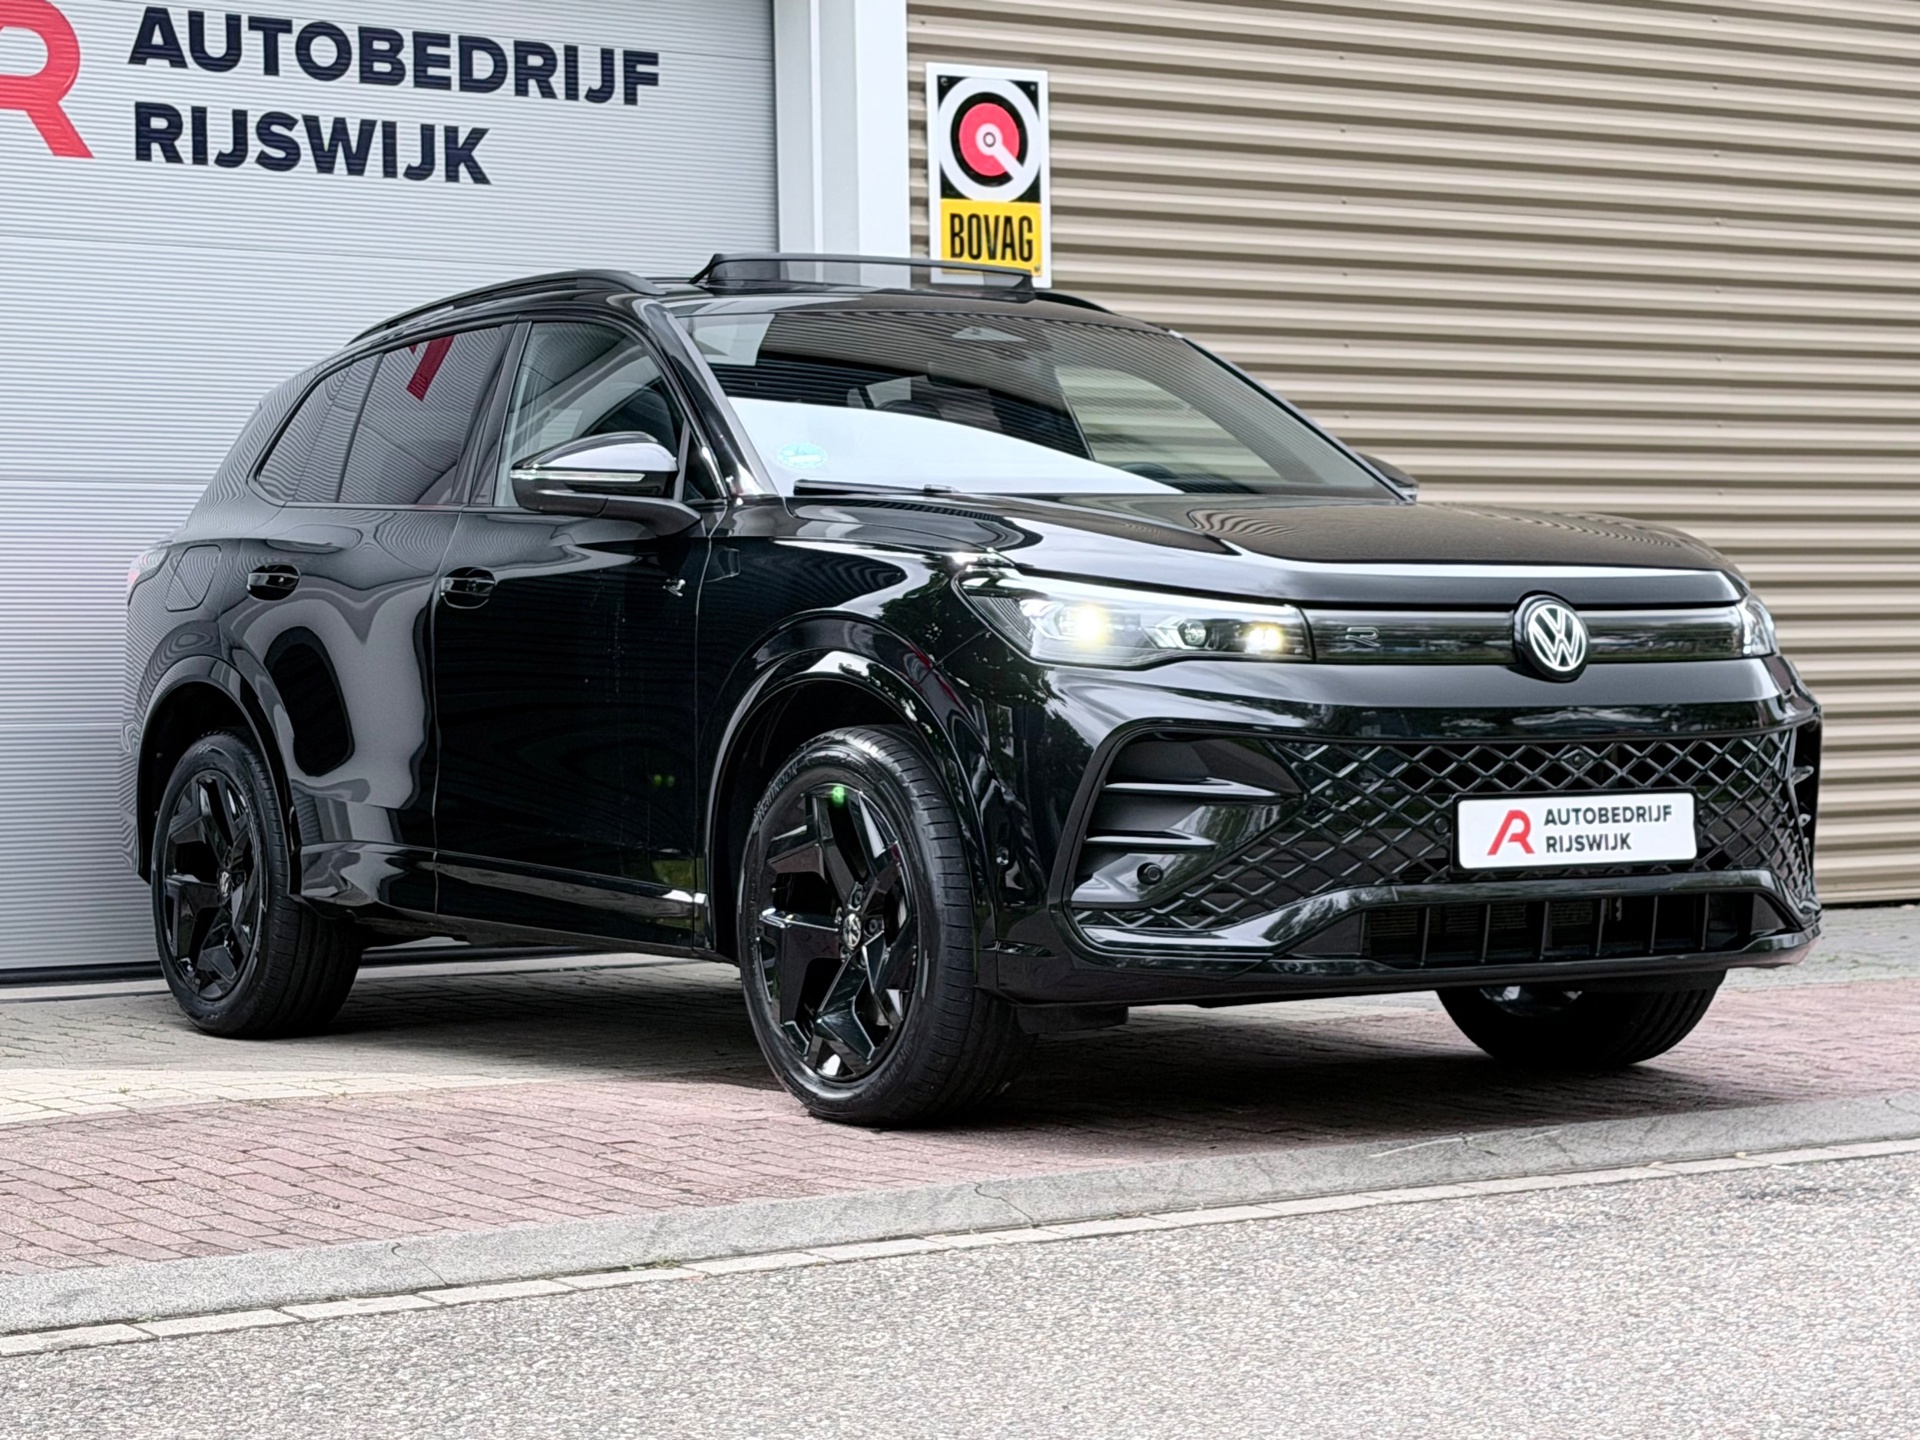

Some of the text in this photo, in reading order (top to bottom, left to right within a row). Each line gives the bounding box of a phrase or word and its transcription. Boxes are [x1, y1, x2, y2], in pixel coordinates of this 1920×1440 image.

[128, 6, 660, 106] AUTOBEDRIJF
[134, 101, 492, 186] RIJSWIJK
[950, 213, 1034, 262] BOVAG
[1544, 804, 1672, 826] AUTOBEDRIJF
[1546, 833, 1632, 853] RIJSWIJK
